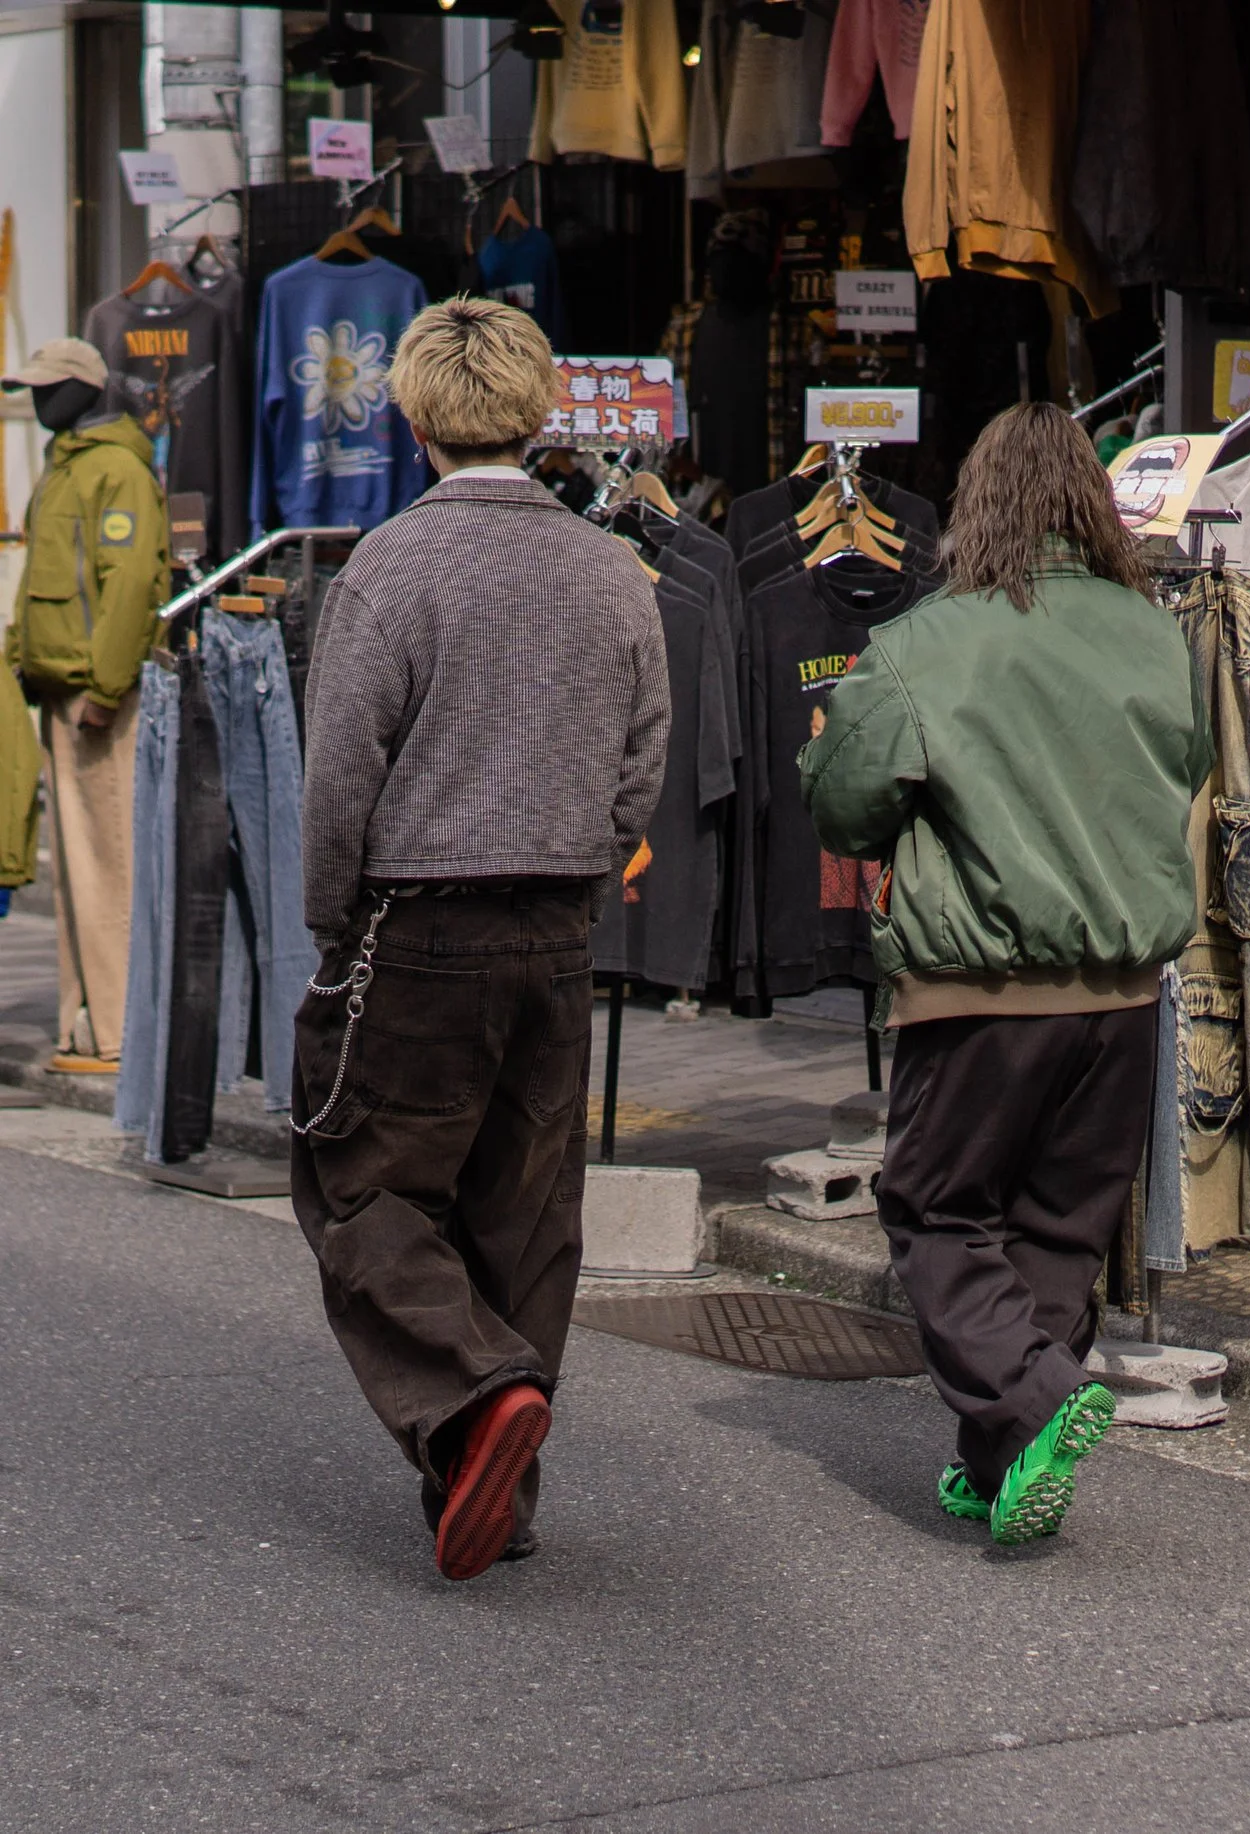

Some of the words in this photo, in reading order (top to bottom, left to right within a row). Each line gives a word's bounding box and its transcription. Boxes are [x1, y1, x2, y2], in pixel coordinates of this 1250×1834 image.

[856, 282, 895, 293] CRAZY
[569, 375, 631, 402] 春物
[543, 408, 660, 435] 大量入荷
[798, 654, 847, 683] HOME
